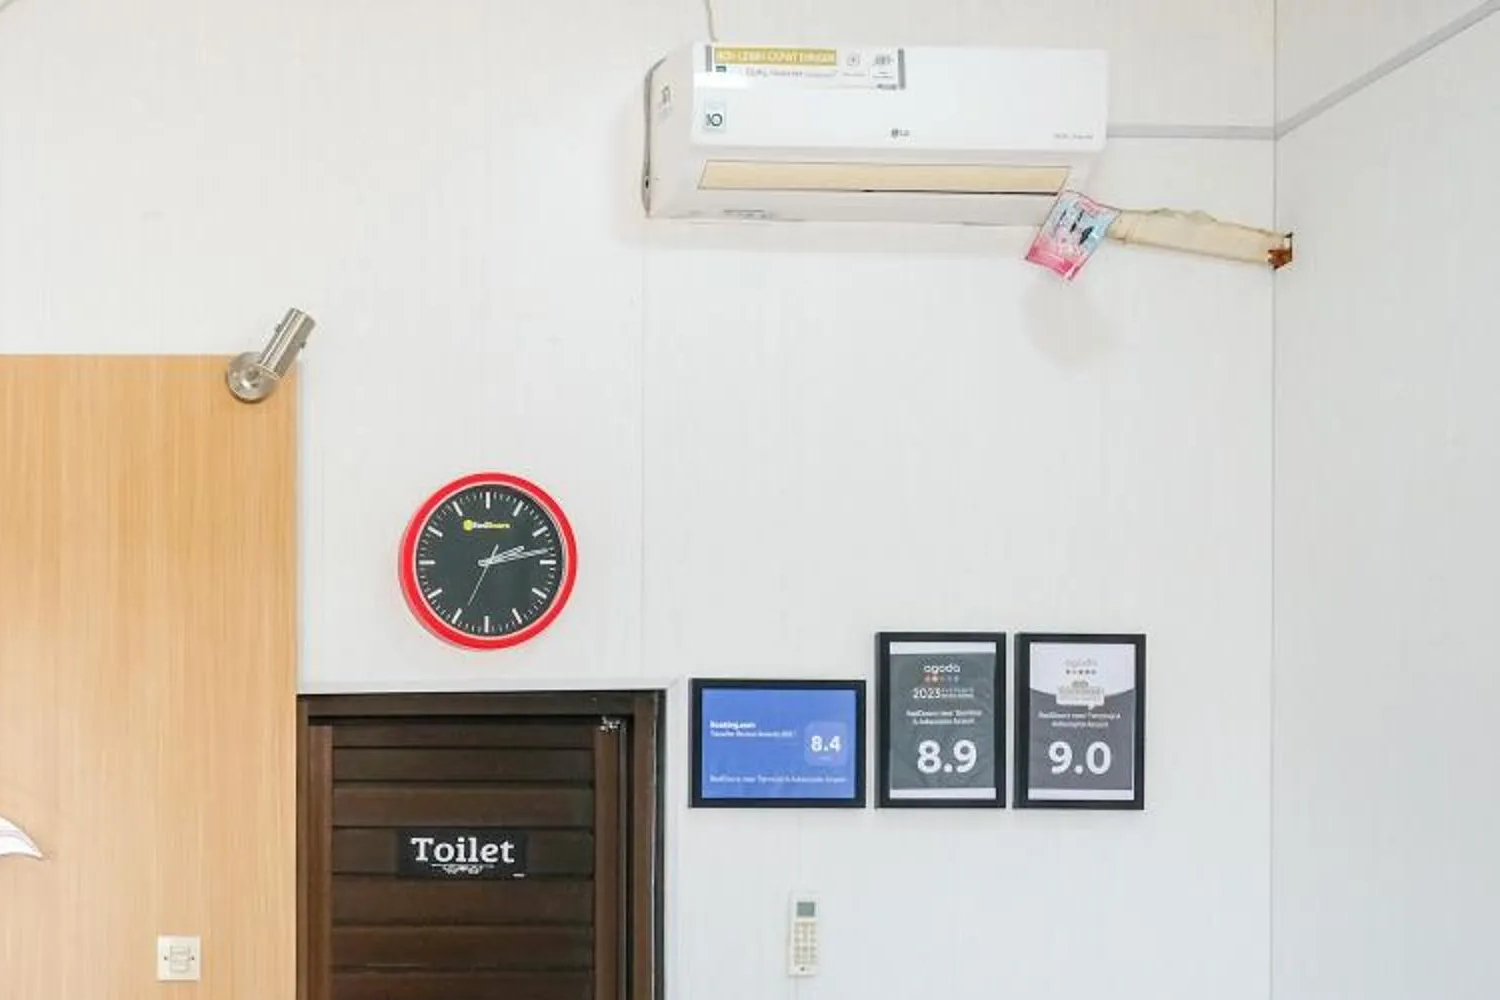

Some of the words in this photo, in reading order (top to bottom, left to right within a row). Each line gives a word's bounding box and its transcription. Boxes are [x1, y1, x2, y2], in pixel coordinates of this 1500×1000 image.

[924, 663, 961, 674] agoda
[811, 735, 842, 753] 8.4
[917, 739, 977, 774] 8.9
[1048, 740, 1112, 775] 9.0
[410, 836, 516, 864] Toilet
